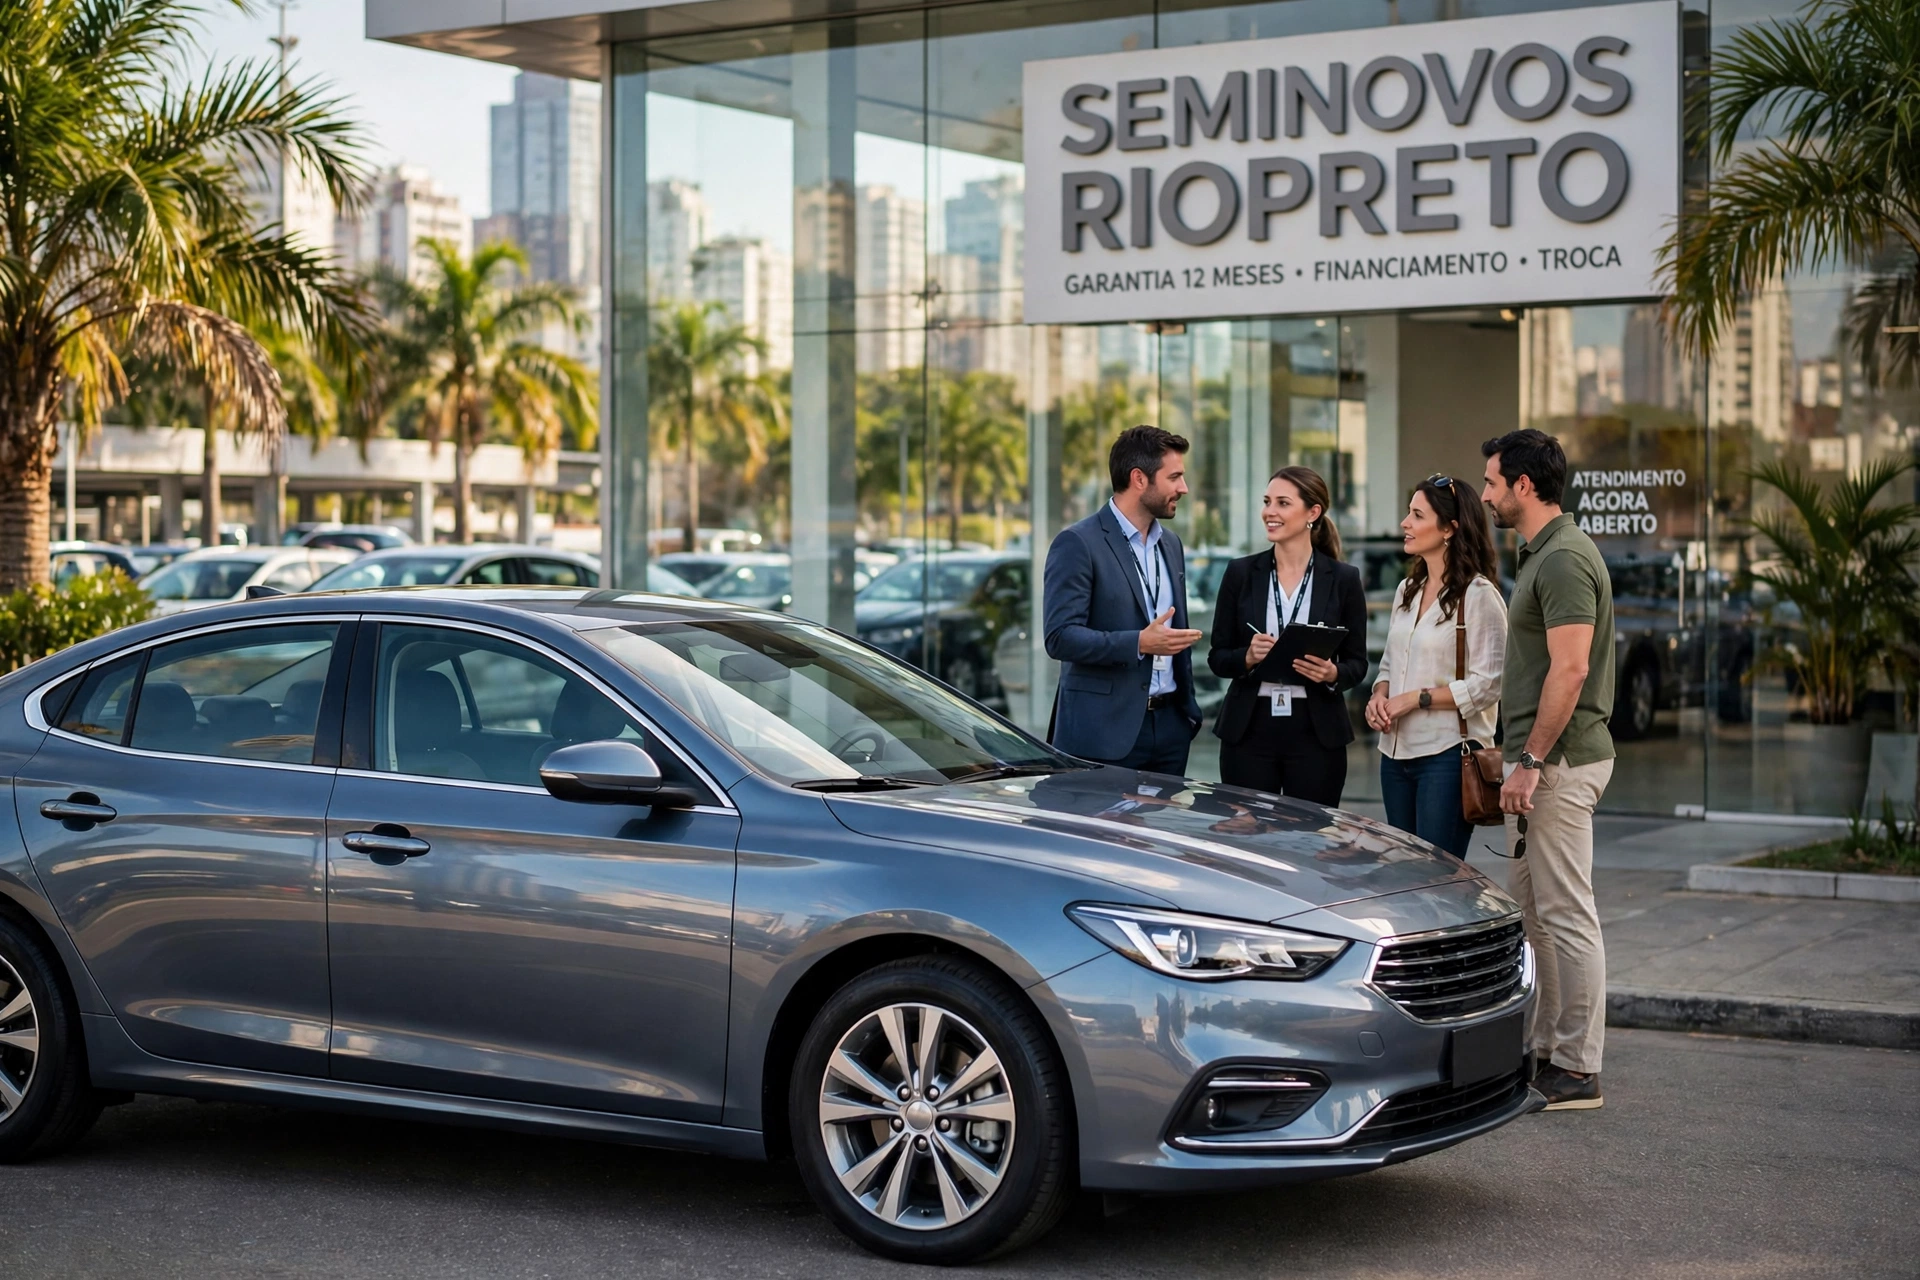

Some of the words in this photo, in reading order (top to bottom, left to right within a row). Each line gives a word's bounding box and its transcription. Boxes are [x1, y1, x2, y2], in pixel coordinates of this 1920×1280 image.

[1060, 36, 1632, 156] SEMINOVOS
[1061, 131, 1630, 253] RIOPRETO
[1065, 270, 1175, 294] GARANTIA
[1182, 268, 1206, 289] 12
[1213, 263, 1285, 287] MESES
[1314, 251, 1508, 281] FINANCIAMENTO
[1538, 245, 1622, 270] TROCA
[1572, 469, 1686, 488] ATENDIMENTO
[1578, 491, 1649, 511] AGORA
[1579, 513, 1658, 534] ABERTO
